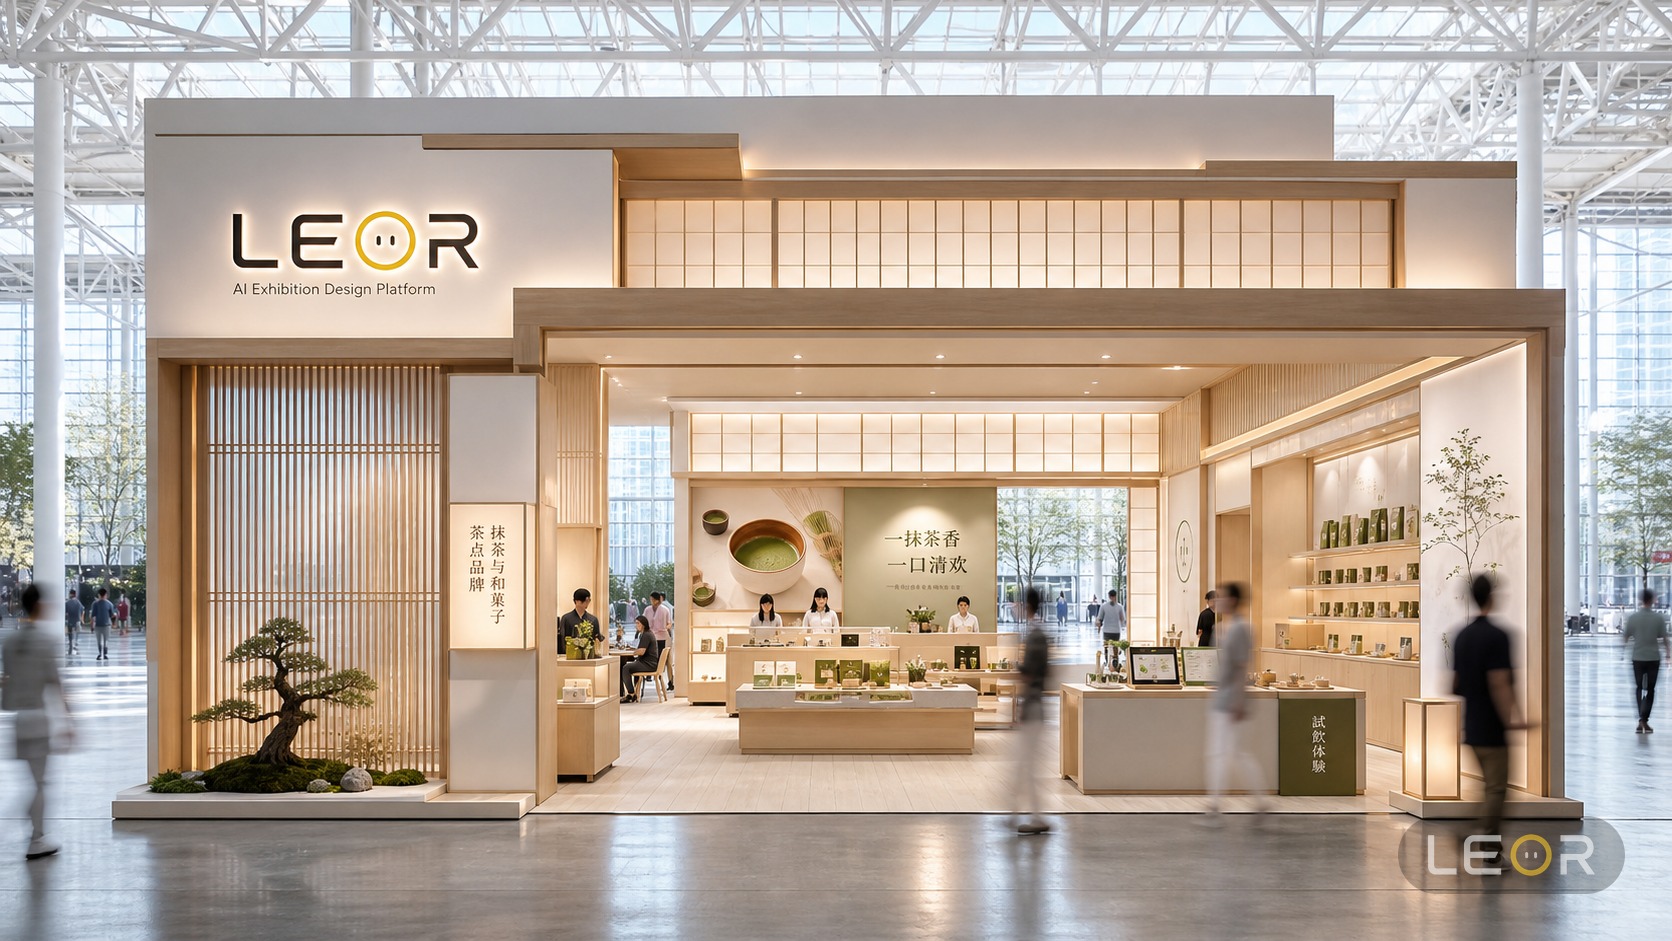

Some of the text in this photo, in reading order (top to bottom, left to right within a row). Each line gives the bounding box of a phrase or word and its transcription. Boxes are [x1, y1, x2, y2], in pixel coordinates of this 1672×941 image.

[232, 211, 479, 270] LEOR
[233, 283, 436, 298] AI Exhibition Design Platform
[884, 530, 960, 548] 一抹茶香
[469, 525, 485, 593] 茶点品牌
[490, 525, 506, 625] 抹茶与和菓子
[887, 555, 968, 574] 一口清欢
